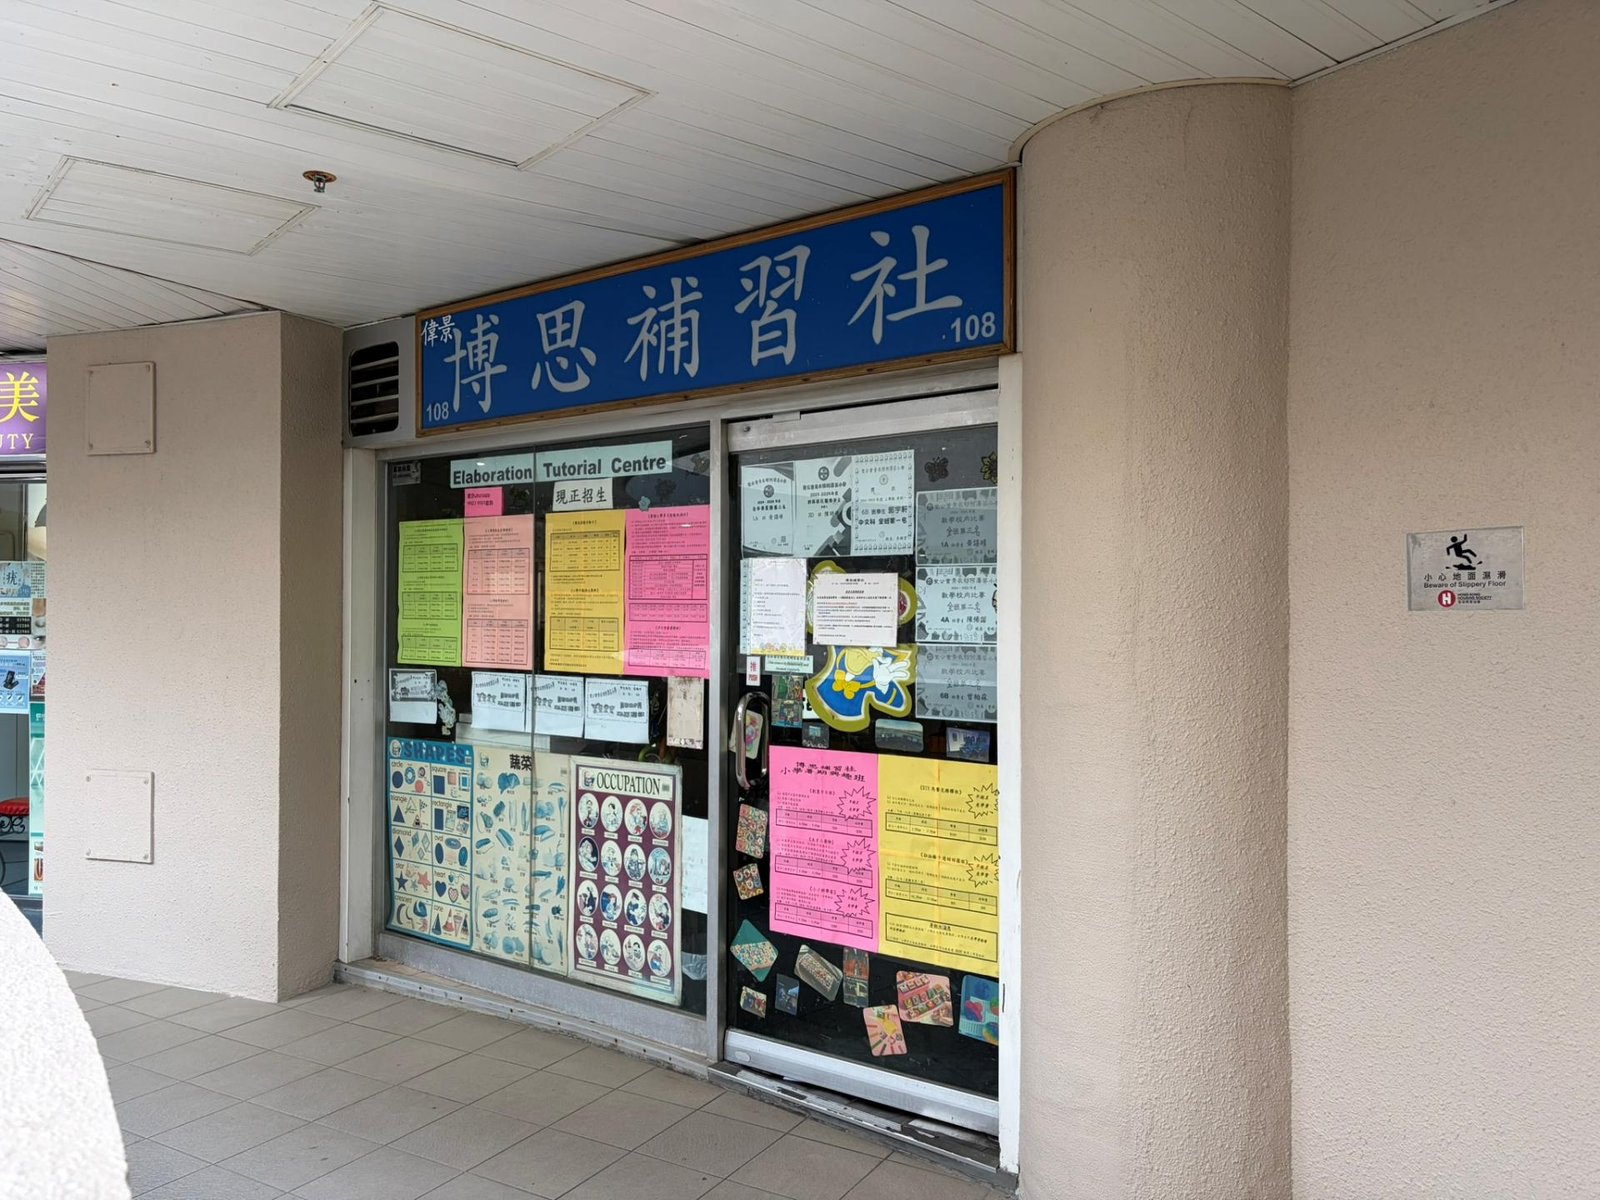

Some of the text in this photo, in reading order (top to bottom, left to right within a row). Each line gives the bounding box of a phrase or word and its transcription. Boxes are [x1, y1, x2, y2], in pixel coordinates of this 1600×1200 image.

[421, 315, 454, 346] 偉景
[444, 225, 962, 413] 博思補習社
[950, 312, 997, 342] 108
[0, 371, 40, 422] 美
[426, 402, 450, 422] 108
[453, 455, 667, 486] Elaboration Tutorial Centre
[555, 487, 607, 505] 現正招生
[1424, 570, 1506, 581] 小心地面濕滑
[1458, 580, 1486, 589] Slippery
[509, 753, 533, 772] 蔬菜
[596, 771, 661, 796] OCCUPATION
